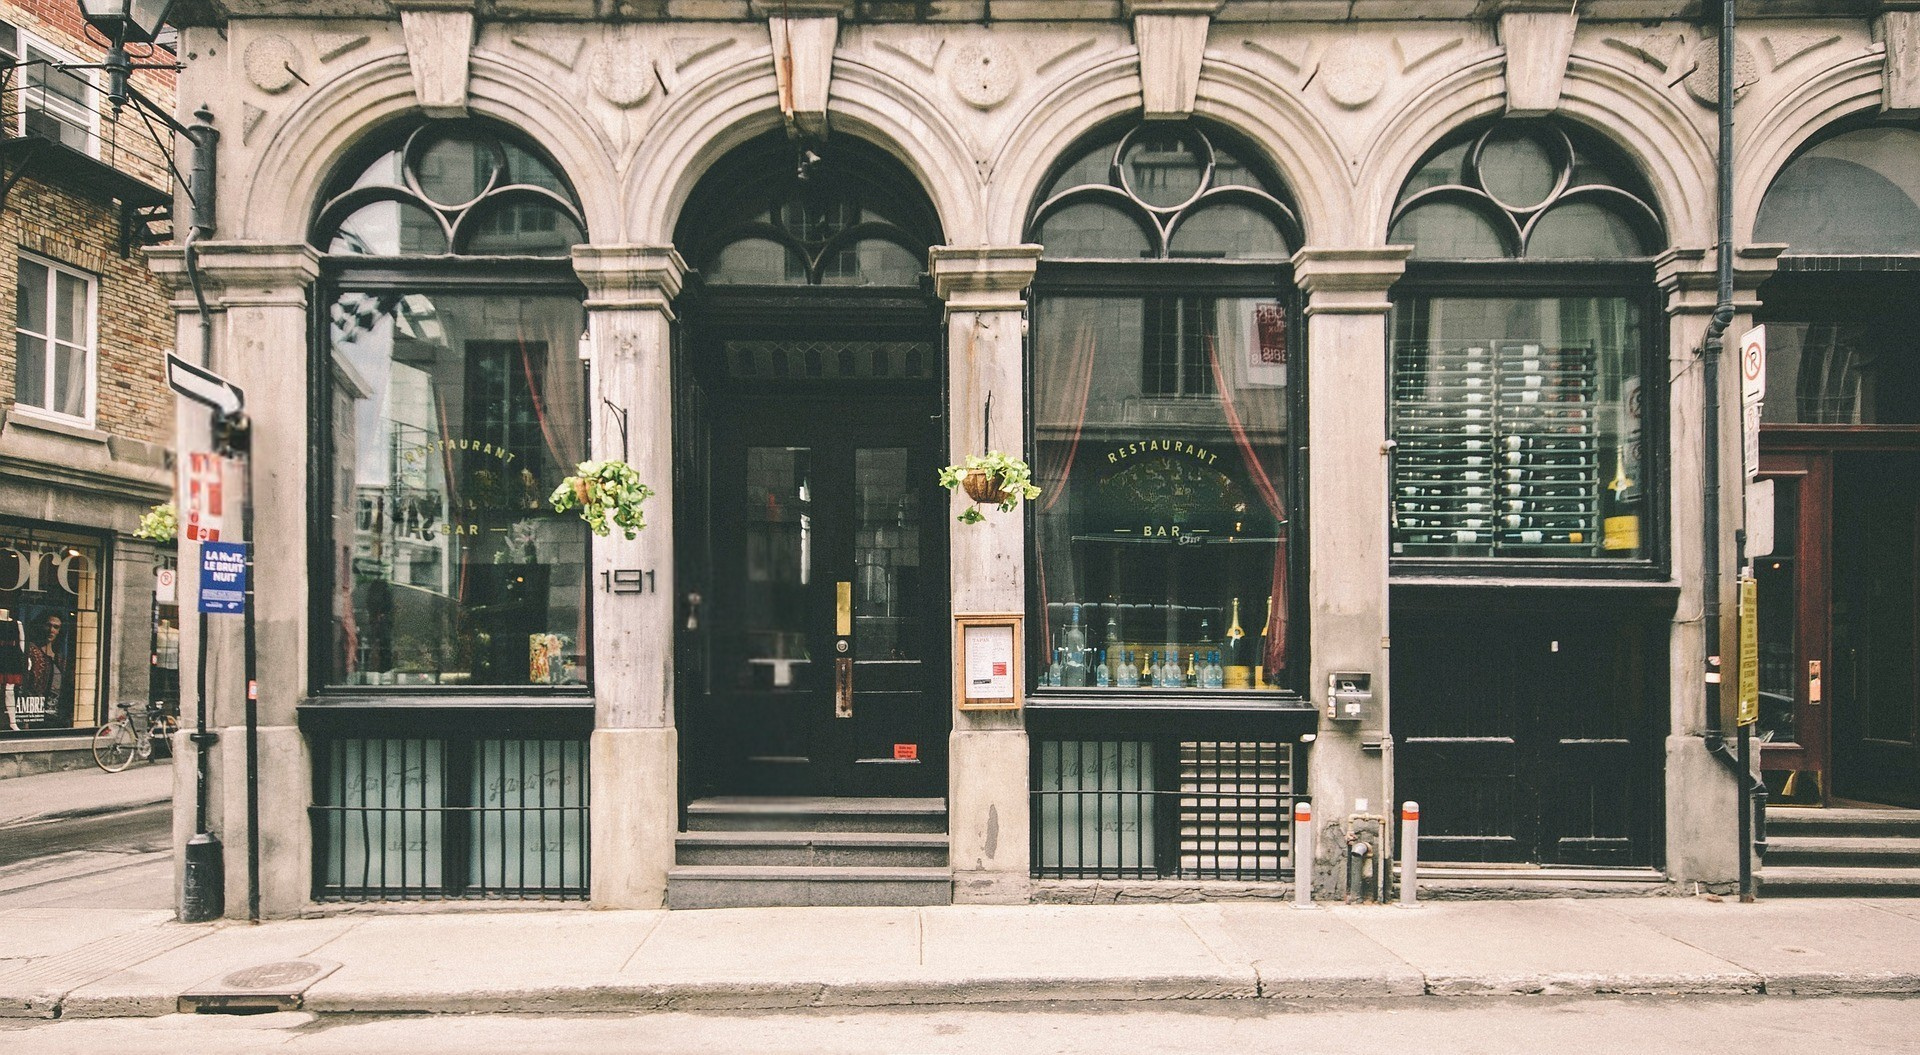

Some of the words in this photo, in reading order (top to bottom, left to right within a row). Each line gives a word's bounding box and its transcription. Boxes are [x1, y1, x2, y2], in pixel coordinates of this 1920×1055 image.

[1107, 440, 1217, 465] RESTAURANT
[441, 524, 479, 535] BAR
[1143, 525, 1180, 537] BAR
[205, 550, 218, 561] LA
[204, 560, 216, 571] LE
[216, 562, 244, 573] BRUIT
[212, 571, 237, 583] NUIT
[600, 569, 655, 594] 191
